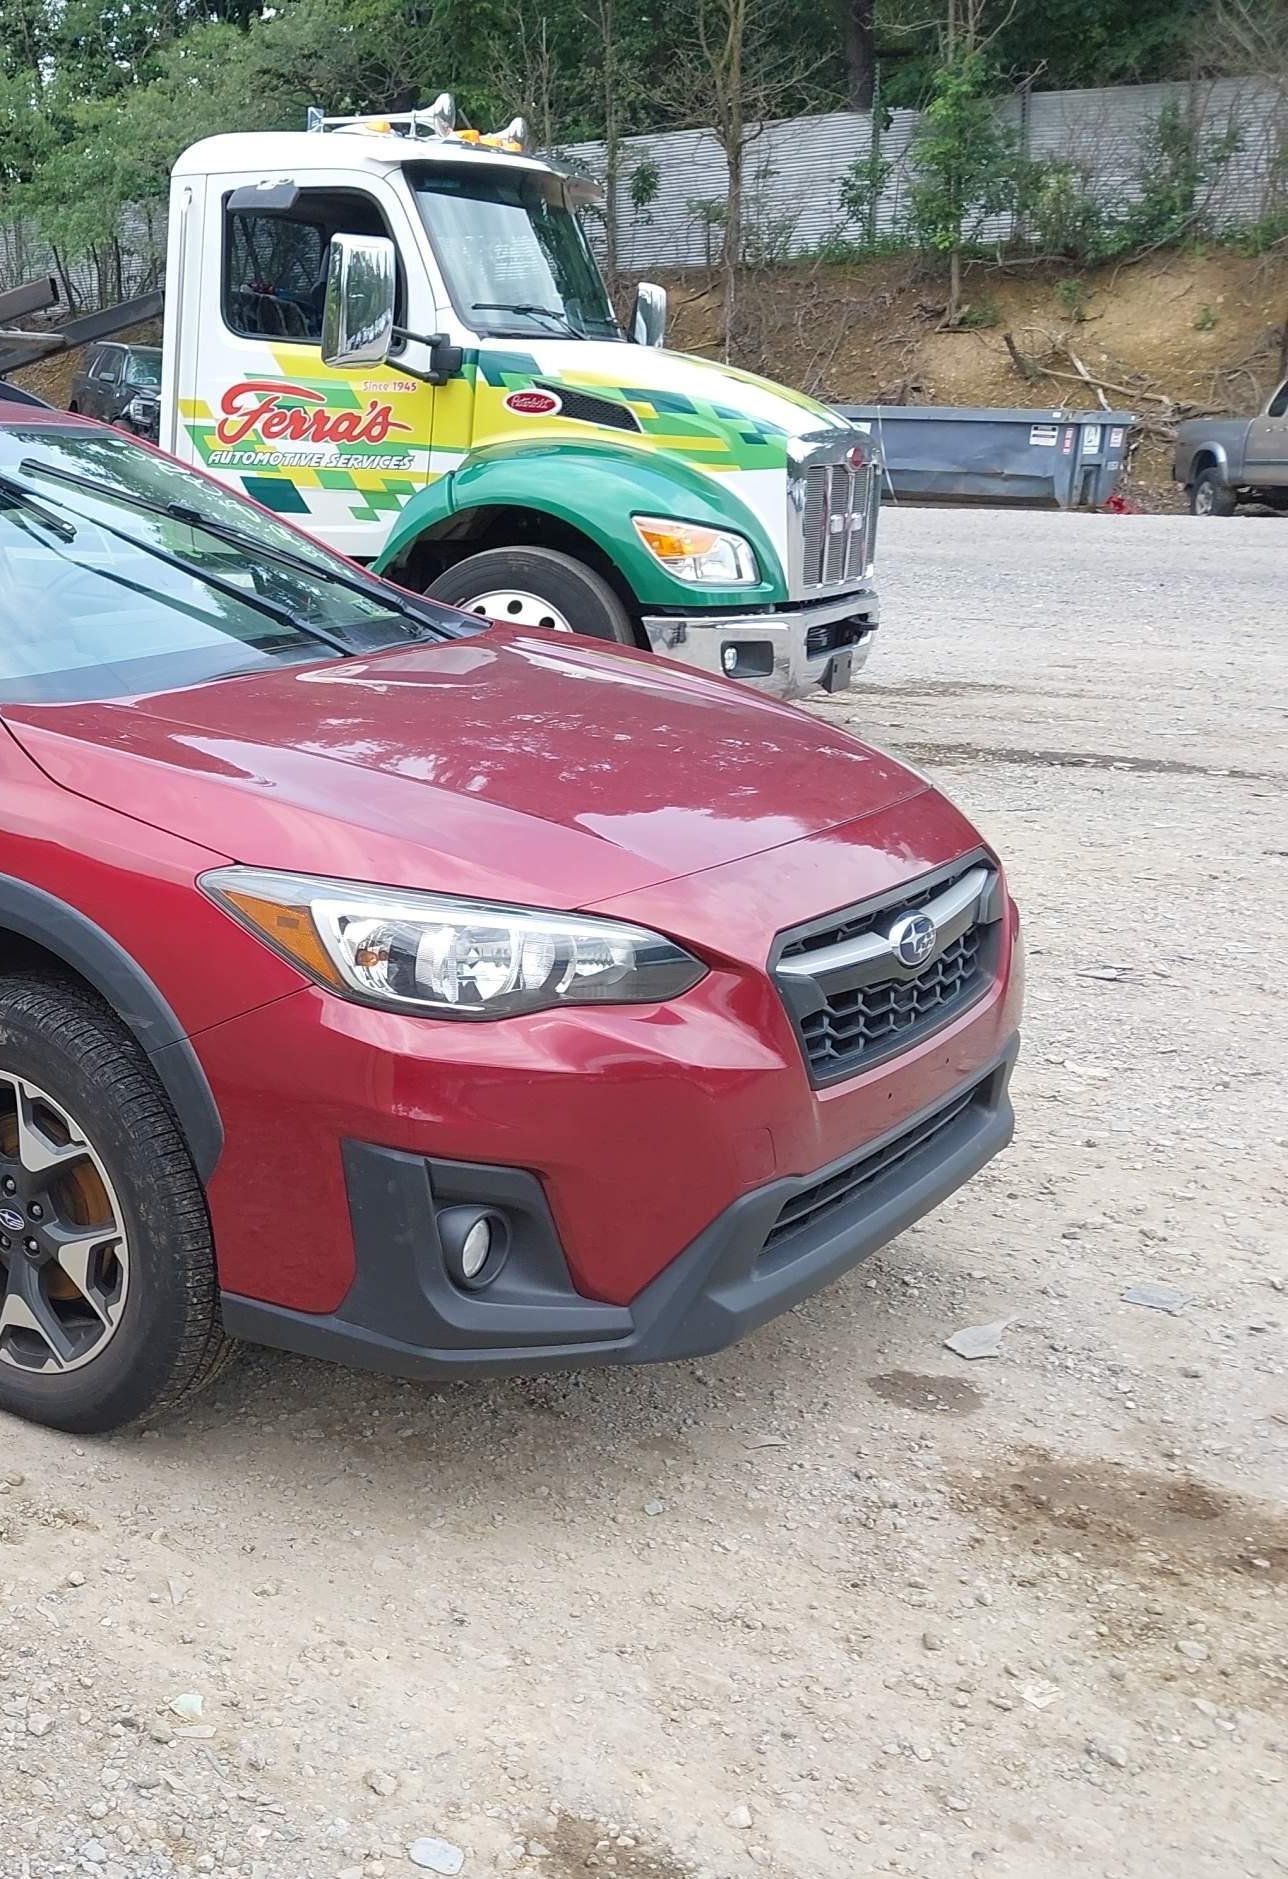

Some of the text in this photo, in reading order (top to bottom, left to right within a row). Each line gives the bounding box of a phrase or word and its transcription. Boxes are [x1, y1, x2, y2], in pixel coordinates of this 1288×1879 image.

[362, 381, 418, 392] Since 1945
[217, 380, 413, 445] Ferra's
[207, 450, 325, 468] AUTOMOTIVE
[324, 454, 416, 470] SERVICES
